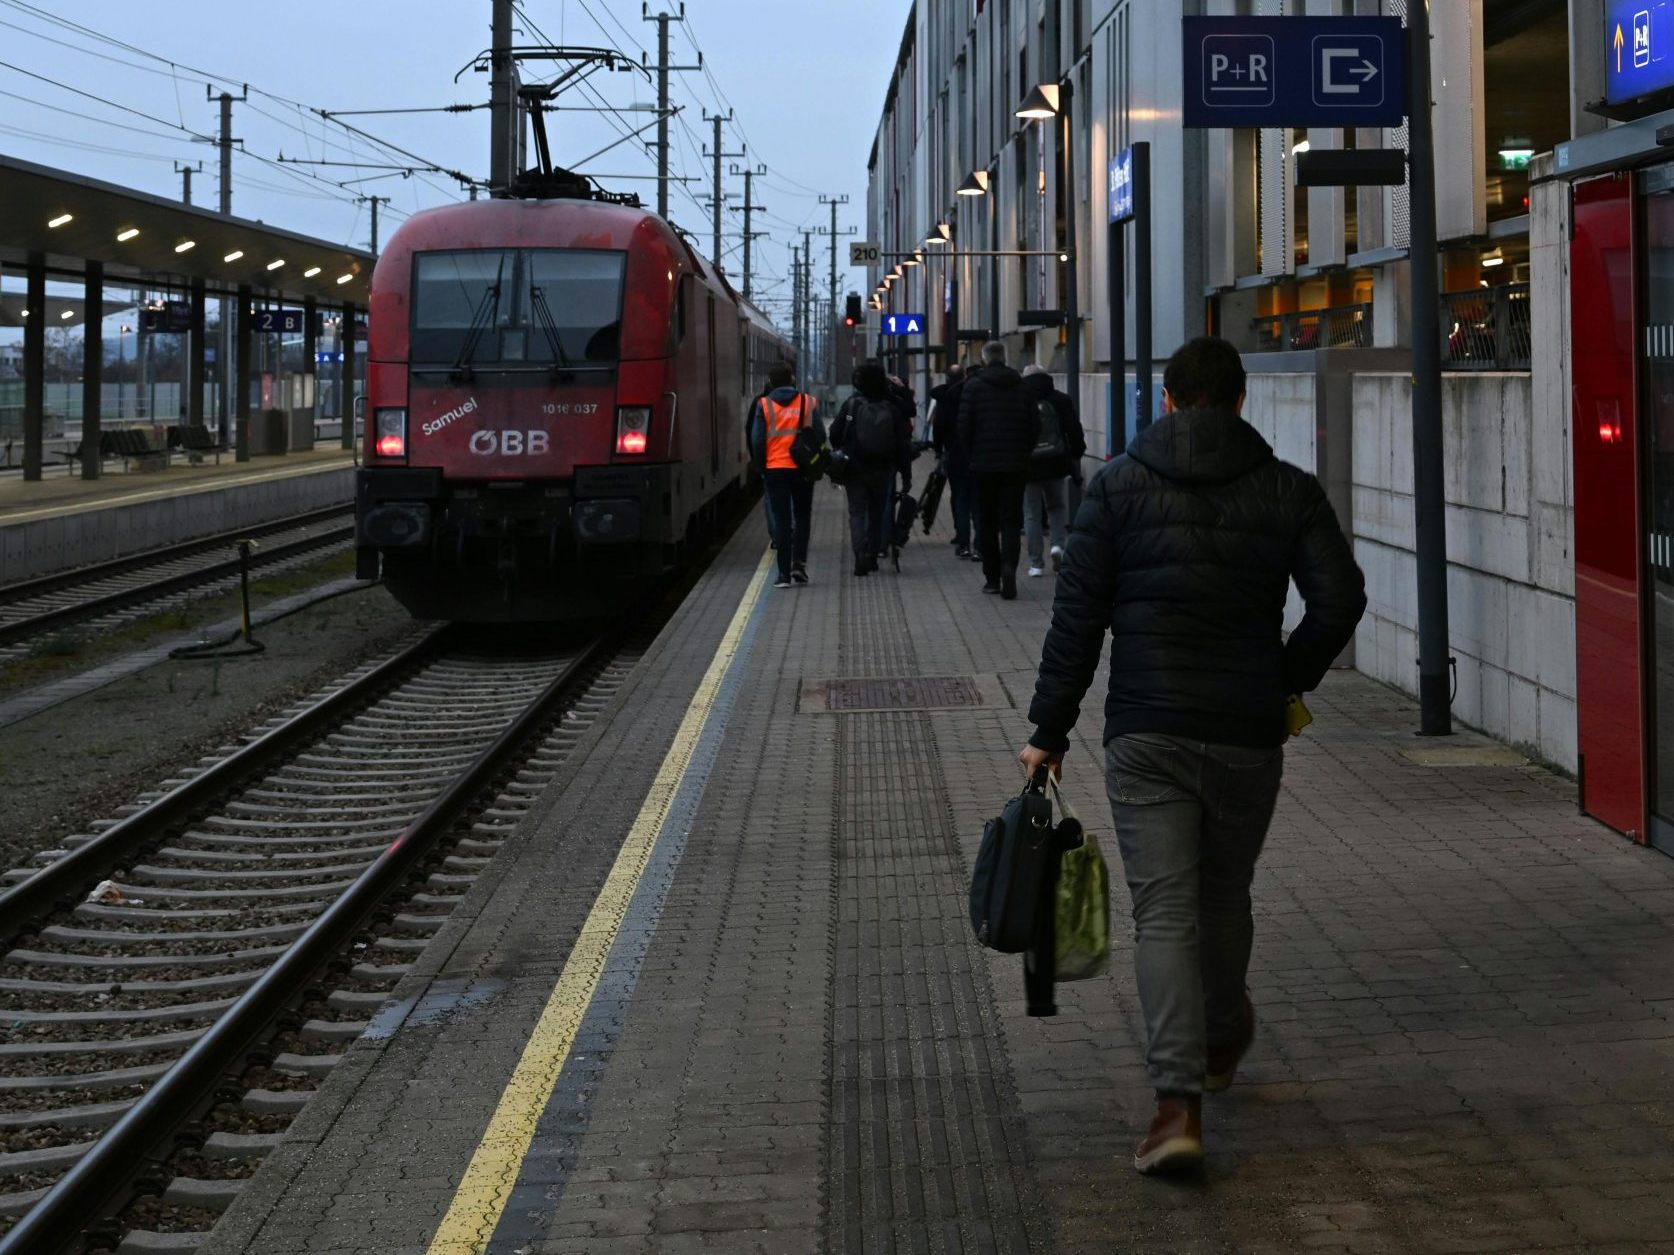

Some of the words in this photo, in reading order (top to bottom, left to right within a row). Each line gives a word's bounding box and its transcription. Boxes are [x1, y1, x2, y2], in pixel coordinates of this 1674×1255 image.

[1635, 25, 1648, 49] P+R
[1211, 54, 1268, 82] P+R
[854, 247, 878, 260] 210
[262, 314, 273, 329] 2
[285, 317, 295, 329] B
[888, 317, 896, 332] 1
[907, 319, 919, 332] A
[422, 397, 478, 435] Samuel
[575, 403, 598, 414] 037
